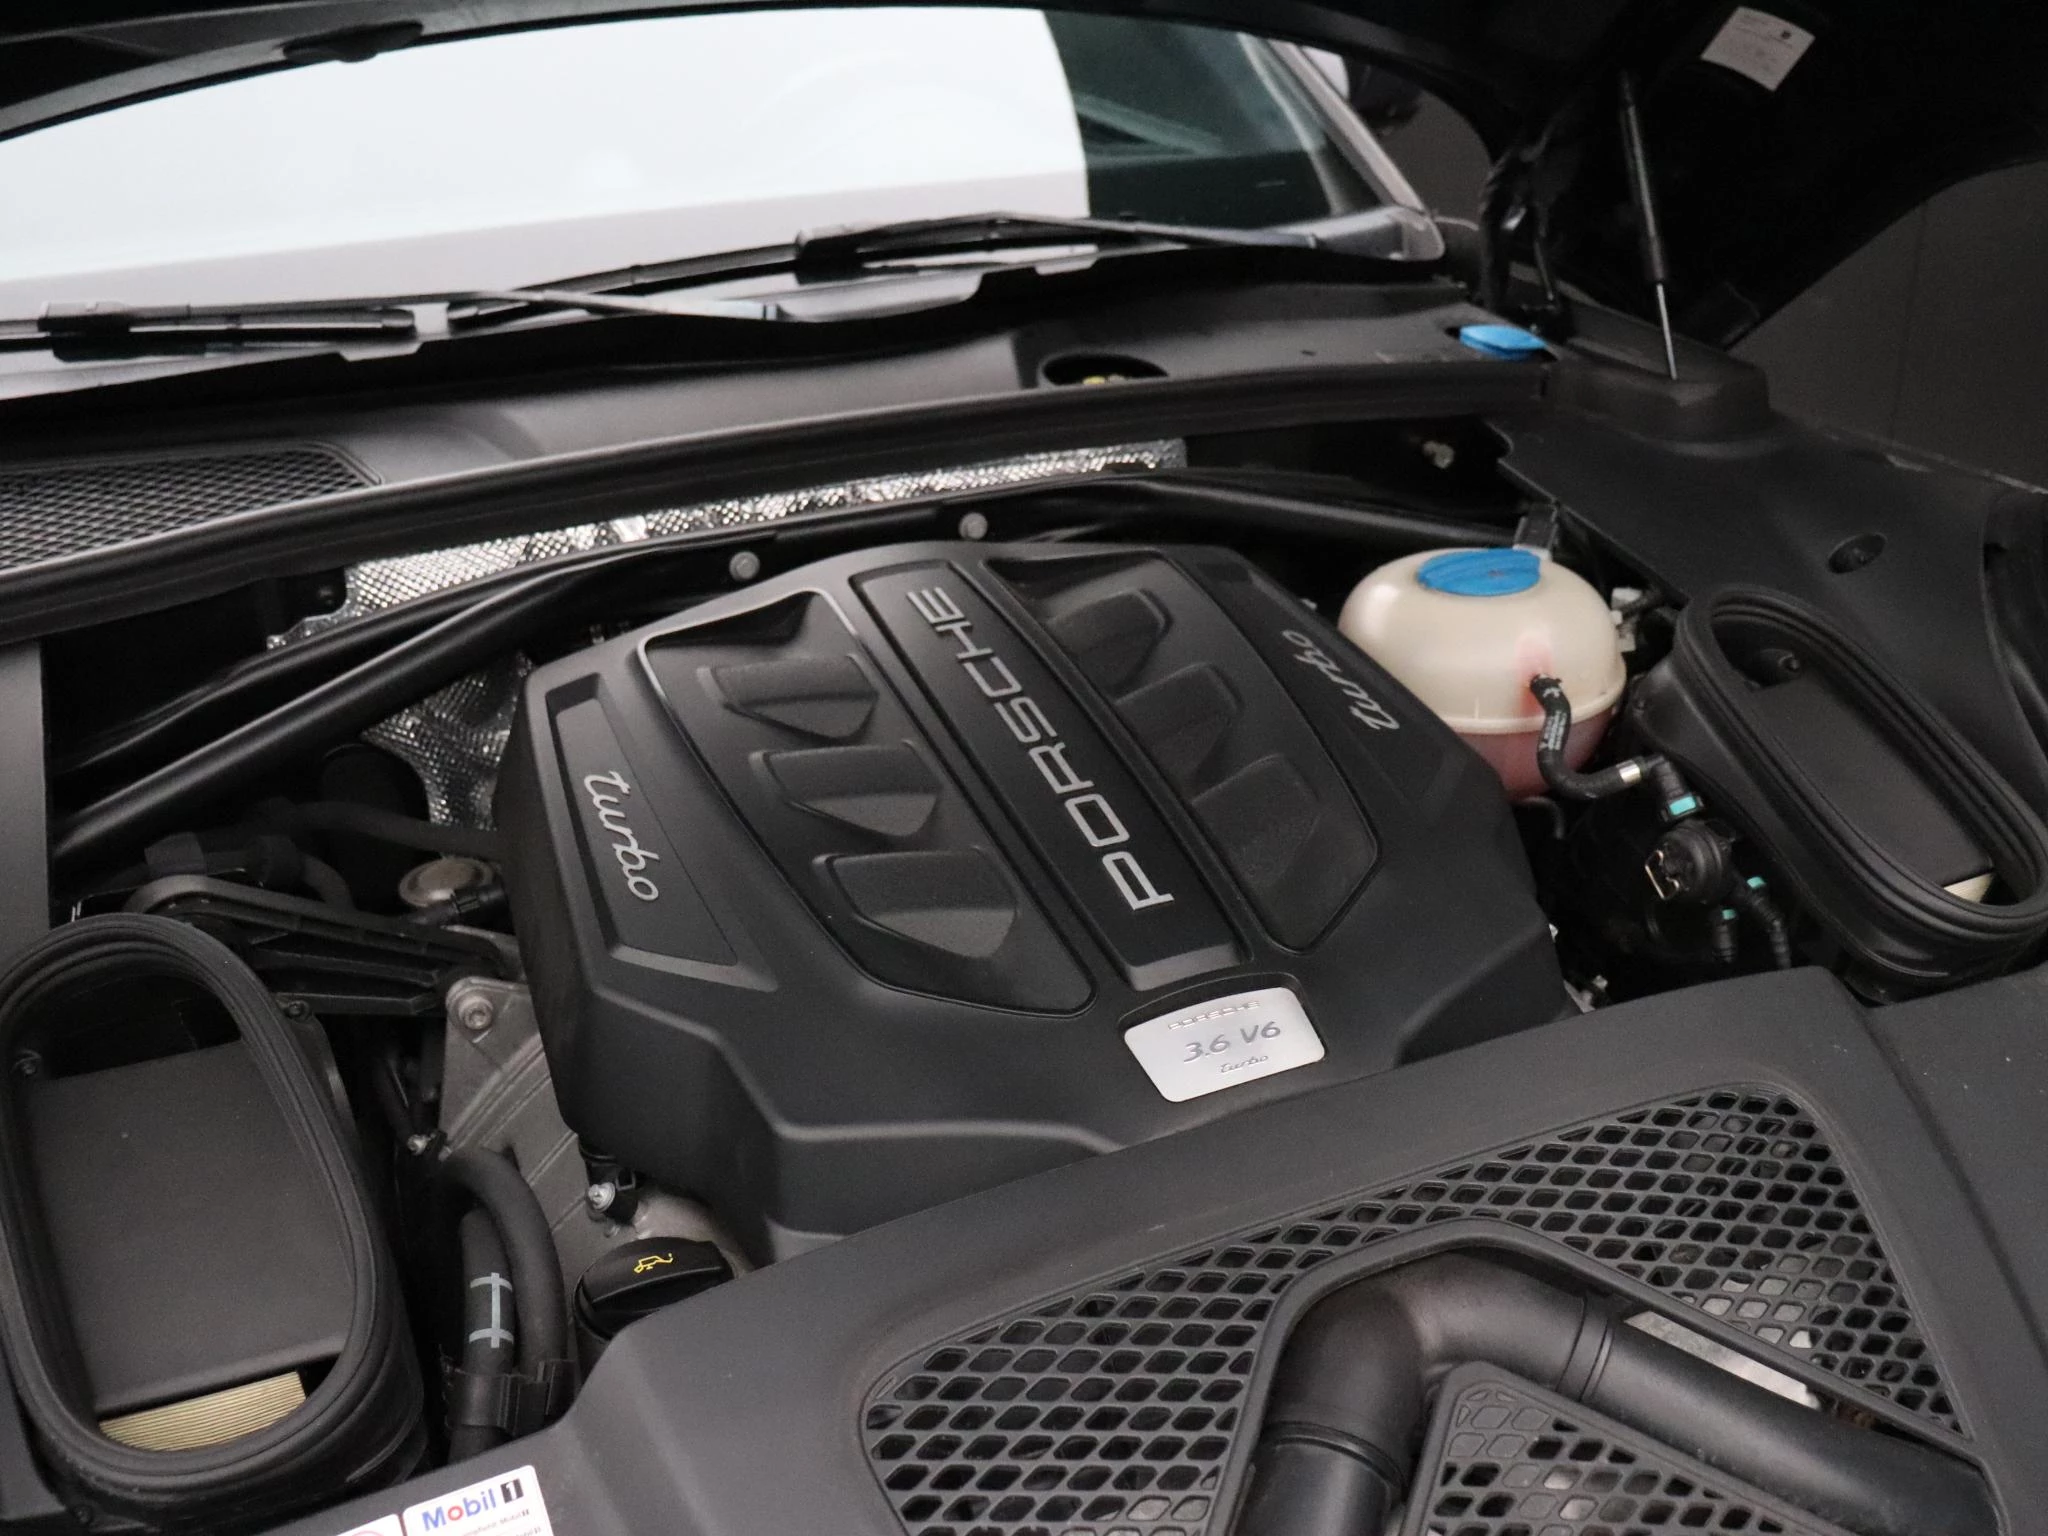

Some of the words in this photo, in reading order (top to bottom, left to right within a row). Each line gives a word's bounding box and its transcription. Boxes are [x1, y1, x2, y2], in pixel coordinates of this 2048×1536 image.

[1282, 630, 1400, 730] turbo
[907, 587, 1175, 910] PORSCHE
[584, 771, 661, 901] turbo
[1183, 1034, 1231, 1063] 3.6
[1240, 1021, 1281, 1044] V6
[1220, 1055, 1269, 1073] turbo
[422, 1488, 497, 1532] Mobil
[503, 1480, 521, 1502] 1
